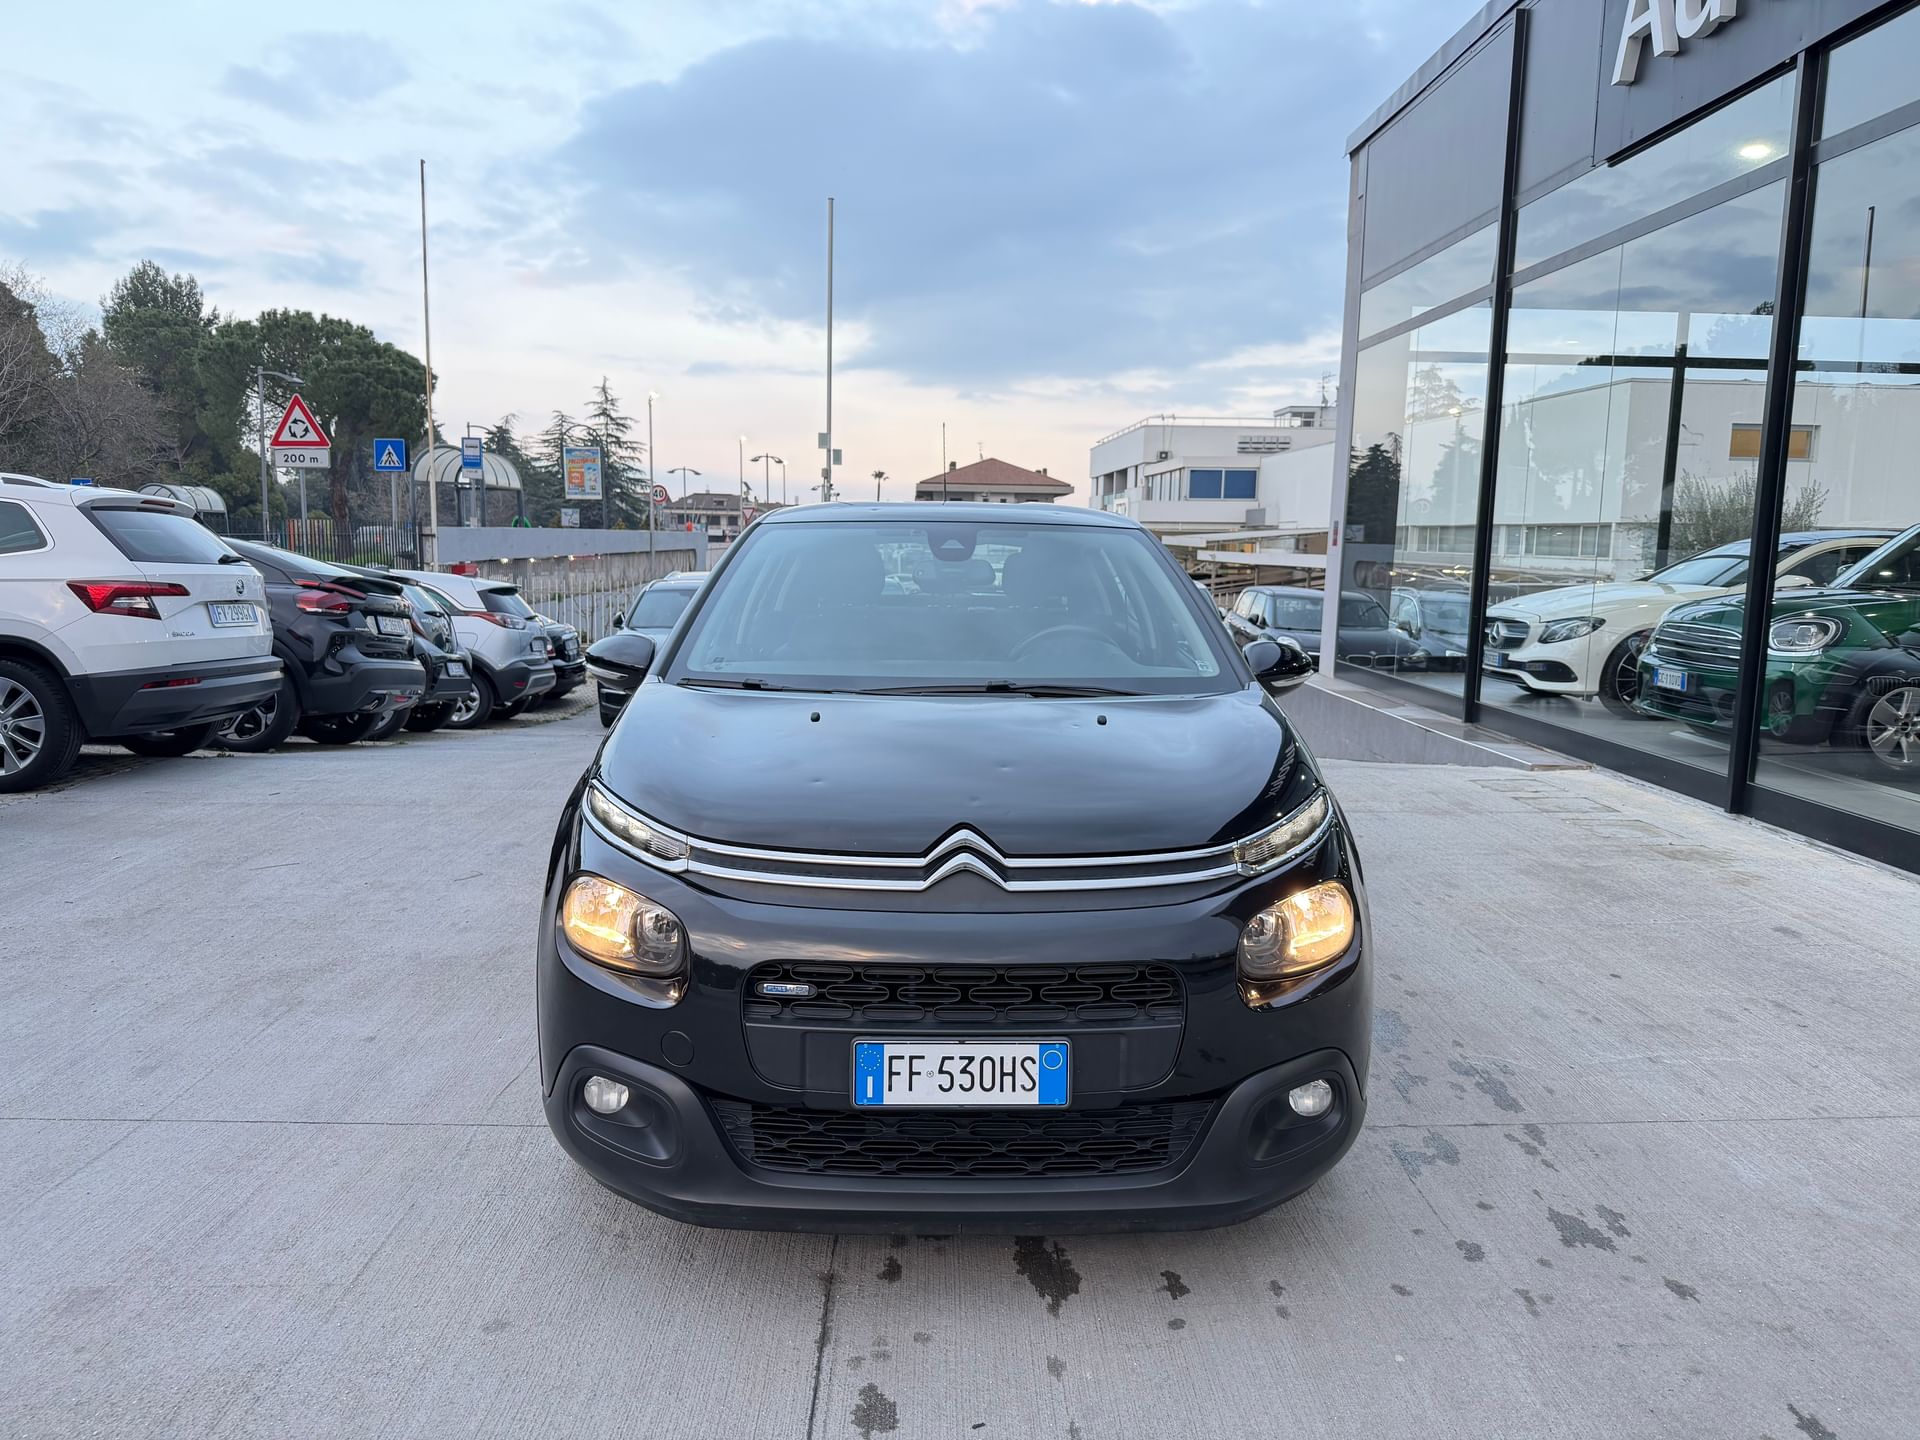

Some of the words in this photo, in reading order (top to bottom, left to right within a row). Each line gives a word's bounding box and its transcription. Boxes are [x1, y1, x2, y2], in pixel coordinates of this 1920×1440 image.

[283, 454, 306, 463] 200
[887, 1055, 926, 1092] FF
[937, 1055, 1037, 1093] 530HS
